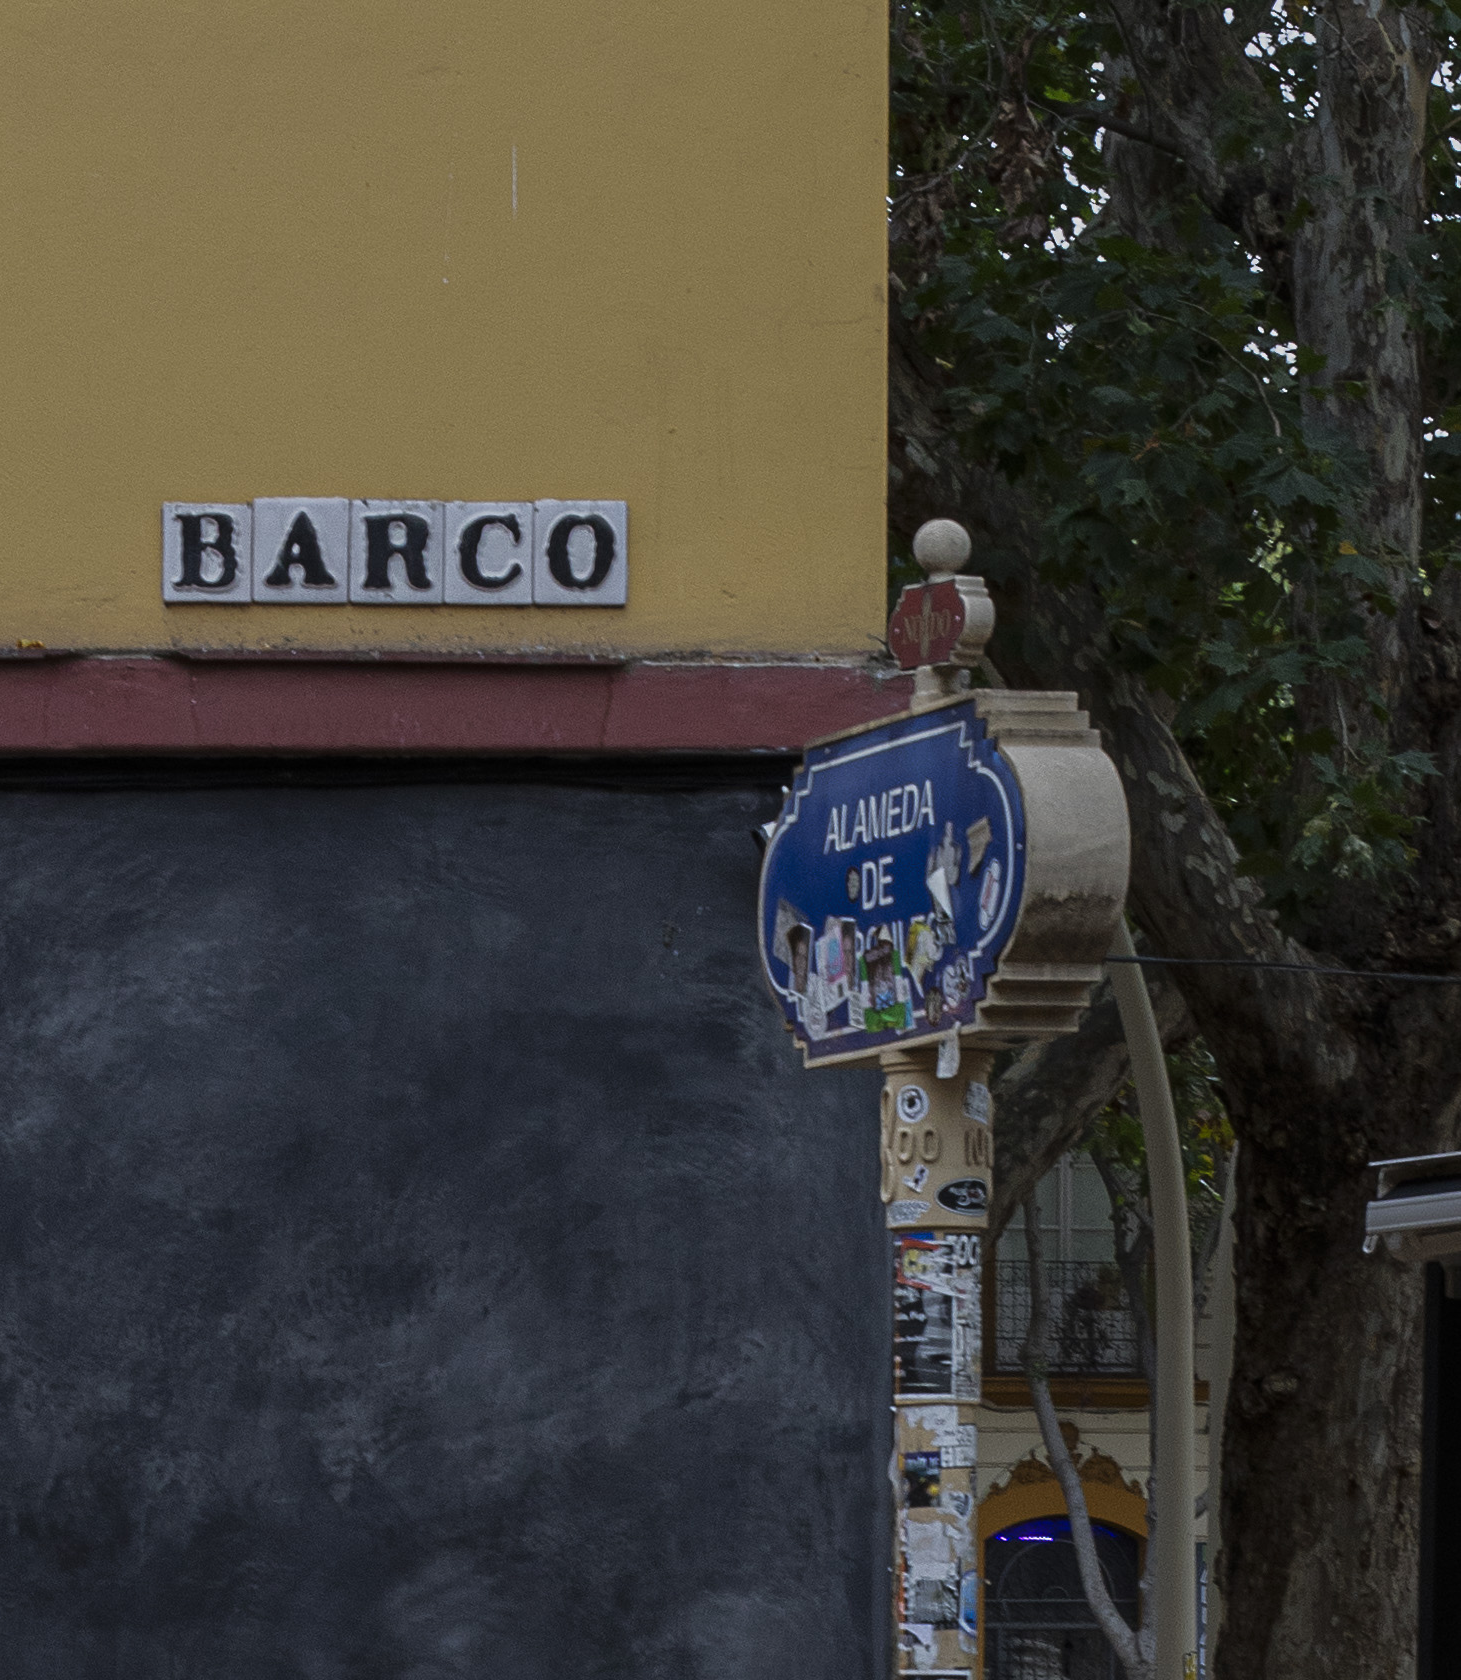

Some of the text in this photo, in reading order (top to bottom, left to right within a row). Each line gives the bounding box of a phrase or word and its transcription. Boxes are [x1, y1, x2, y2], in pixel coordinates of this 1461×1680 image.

[172, 510, 617, 591] BARCO
[823, 779, 936, 855] ALAMEDA
[861, 855, 895, 910] DE
